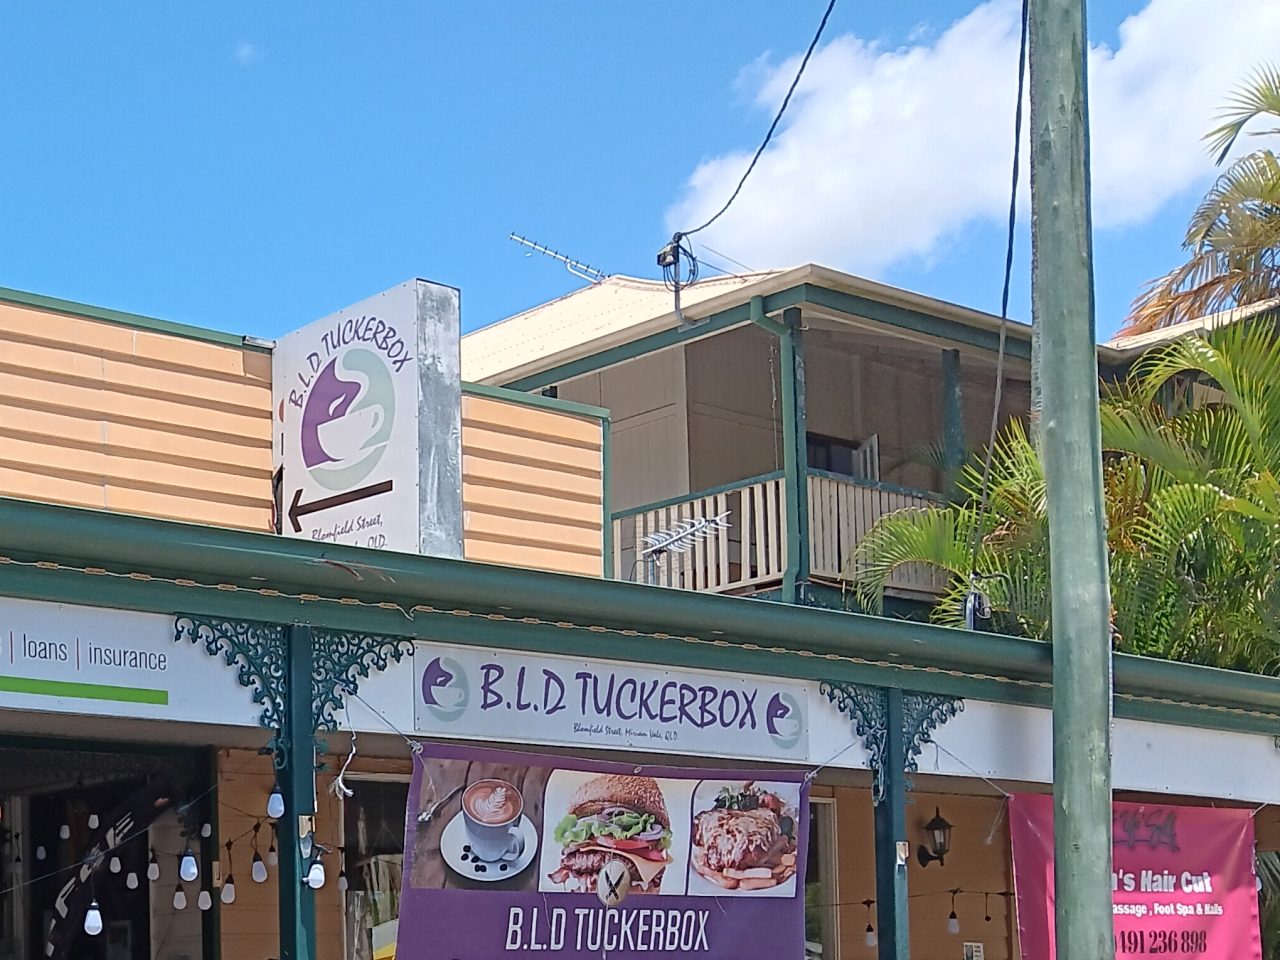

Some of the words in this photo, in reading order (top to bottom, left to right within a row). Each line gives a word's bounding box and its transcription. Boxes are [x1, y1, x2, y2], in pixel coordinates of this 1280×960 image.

[321, 315, 414, 374] TUCKERBOX
[22, 633, 68, 661] loans
[88, 642, 168, 671] insurance
[479, 663, 566, 713] B.L.D
[575, 671, 759, 731] TUCKERBOX
[1140, 869, 1177, 893] Hair
[1180, 871, 1213, 894] Cut
[504, 906, 568, 952] B.L.D
[573, 907, 710, 952] TUCKERBOX
[1112, 904, 1147, 917] assage
[1153, 903, 1175, 915] Foot
[1176, 904, 1195, 917] Spa
[1195, 903, 1203, 915] &
[1114, 930, 1146, 954] 491
[1147, 930, 1179, 954] 236
[1180, 930, 1208, 954] 898
